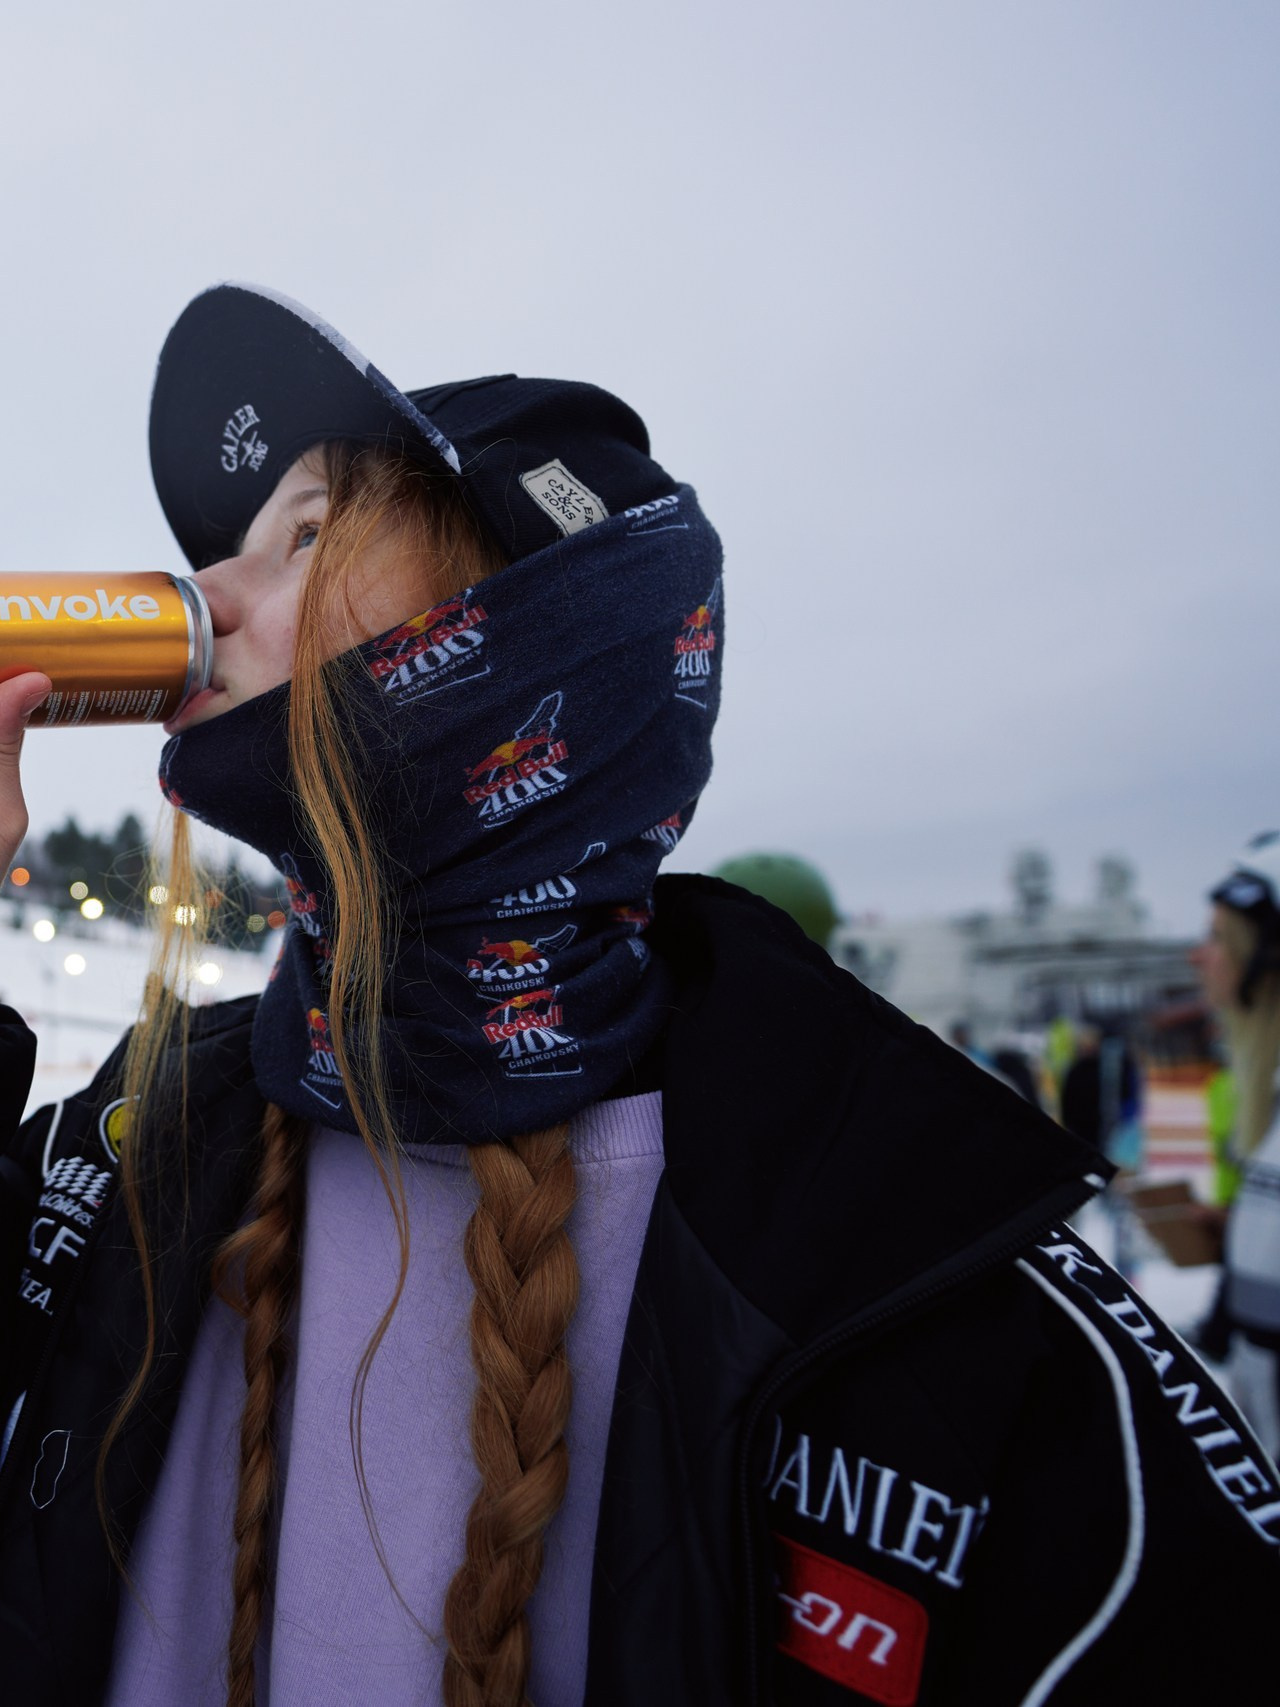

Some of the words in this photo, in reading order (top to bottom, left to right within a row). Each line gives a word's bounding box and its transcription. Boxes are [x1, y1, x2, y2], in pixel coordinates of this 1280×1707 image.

[221, 404, 261, 472] CAYLER
[542, 492, 577, 521] SONS
[548, 478, 594, 525] CAYLER
[369, 636, 429, 680] Red
[429, 604, 488, 645] Bull
[384, 629, 484, 693] 400
[673, 649, 710, 678] 400
[463, 767, 519, 805] Red
[516, 740, 569, 778] Bull
[479, 765, 567, 818] 400
[496, 901, 573, 919] CHAIKOVSKY
[482, 1010, 532, 1045] Red
[522, 1005, 563, 1028] Bull
[508, 1042, 580, 1070] CHAIKOVSKY
